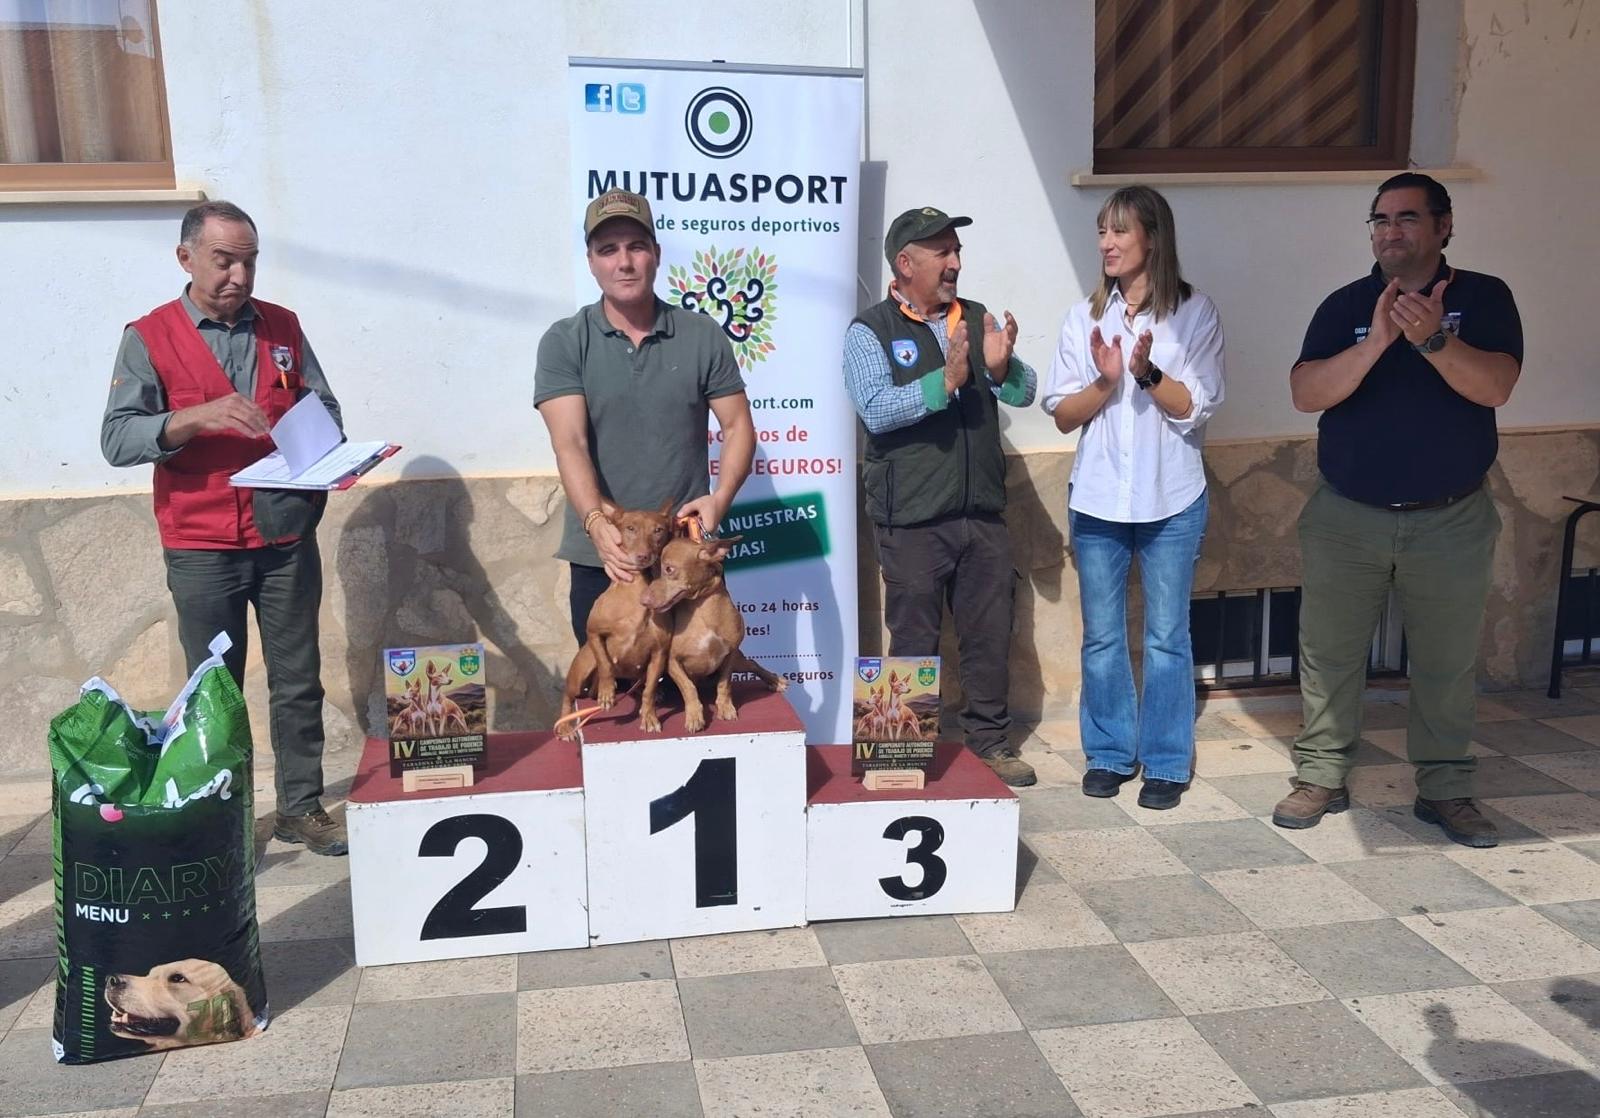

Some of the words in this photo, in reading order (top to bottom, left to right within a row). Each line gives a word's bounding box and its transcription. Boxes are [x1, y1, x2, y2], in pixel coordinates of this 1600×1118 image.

[587, 169, 847, 204] MUTUASPORT
[656, 214, 675, 230] de
[681, 217, 745, 235] seguros
[751, 216, 840, 236] deportivos
[748, 397, 814, 410] ort.com
[786, 425, 808, 442] de
[750, 458, 842, 475] EGUROS!
[729, 505, 817, 532] NUESTRAS
[761, 602, 777, 613] 24
[782, 599, 820, 612] horas
[782, 671, 834, 684] seguros
[392, 740, 416, 759] IV
[855, 742, 876, 760] IV
[649, 757, 738, 908] 1
[878, 815, 948, 901] 3
[74, 852, 237, 905] DIARY
[418, 813, 528, 941] 2
[76, 903, 130, 923] MENU
